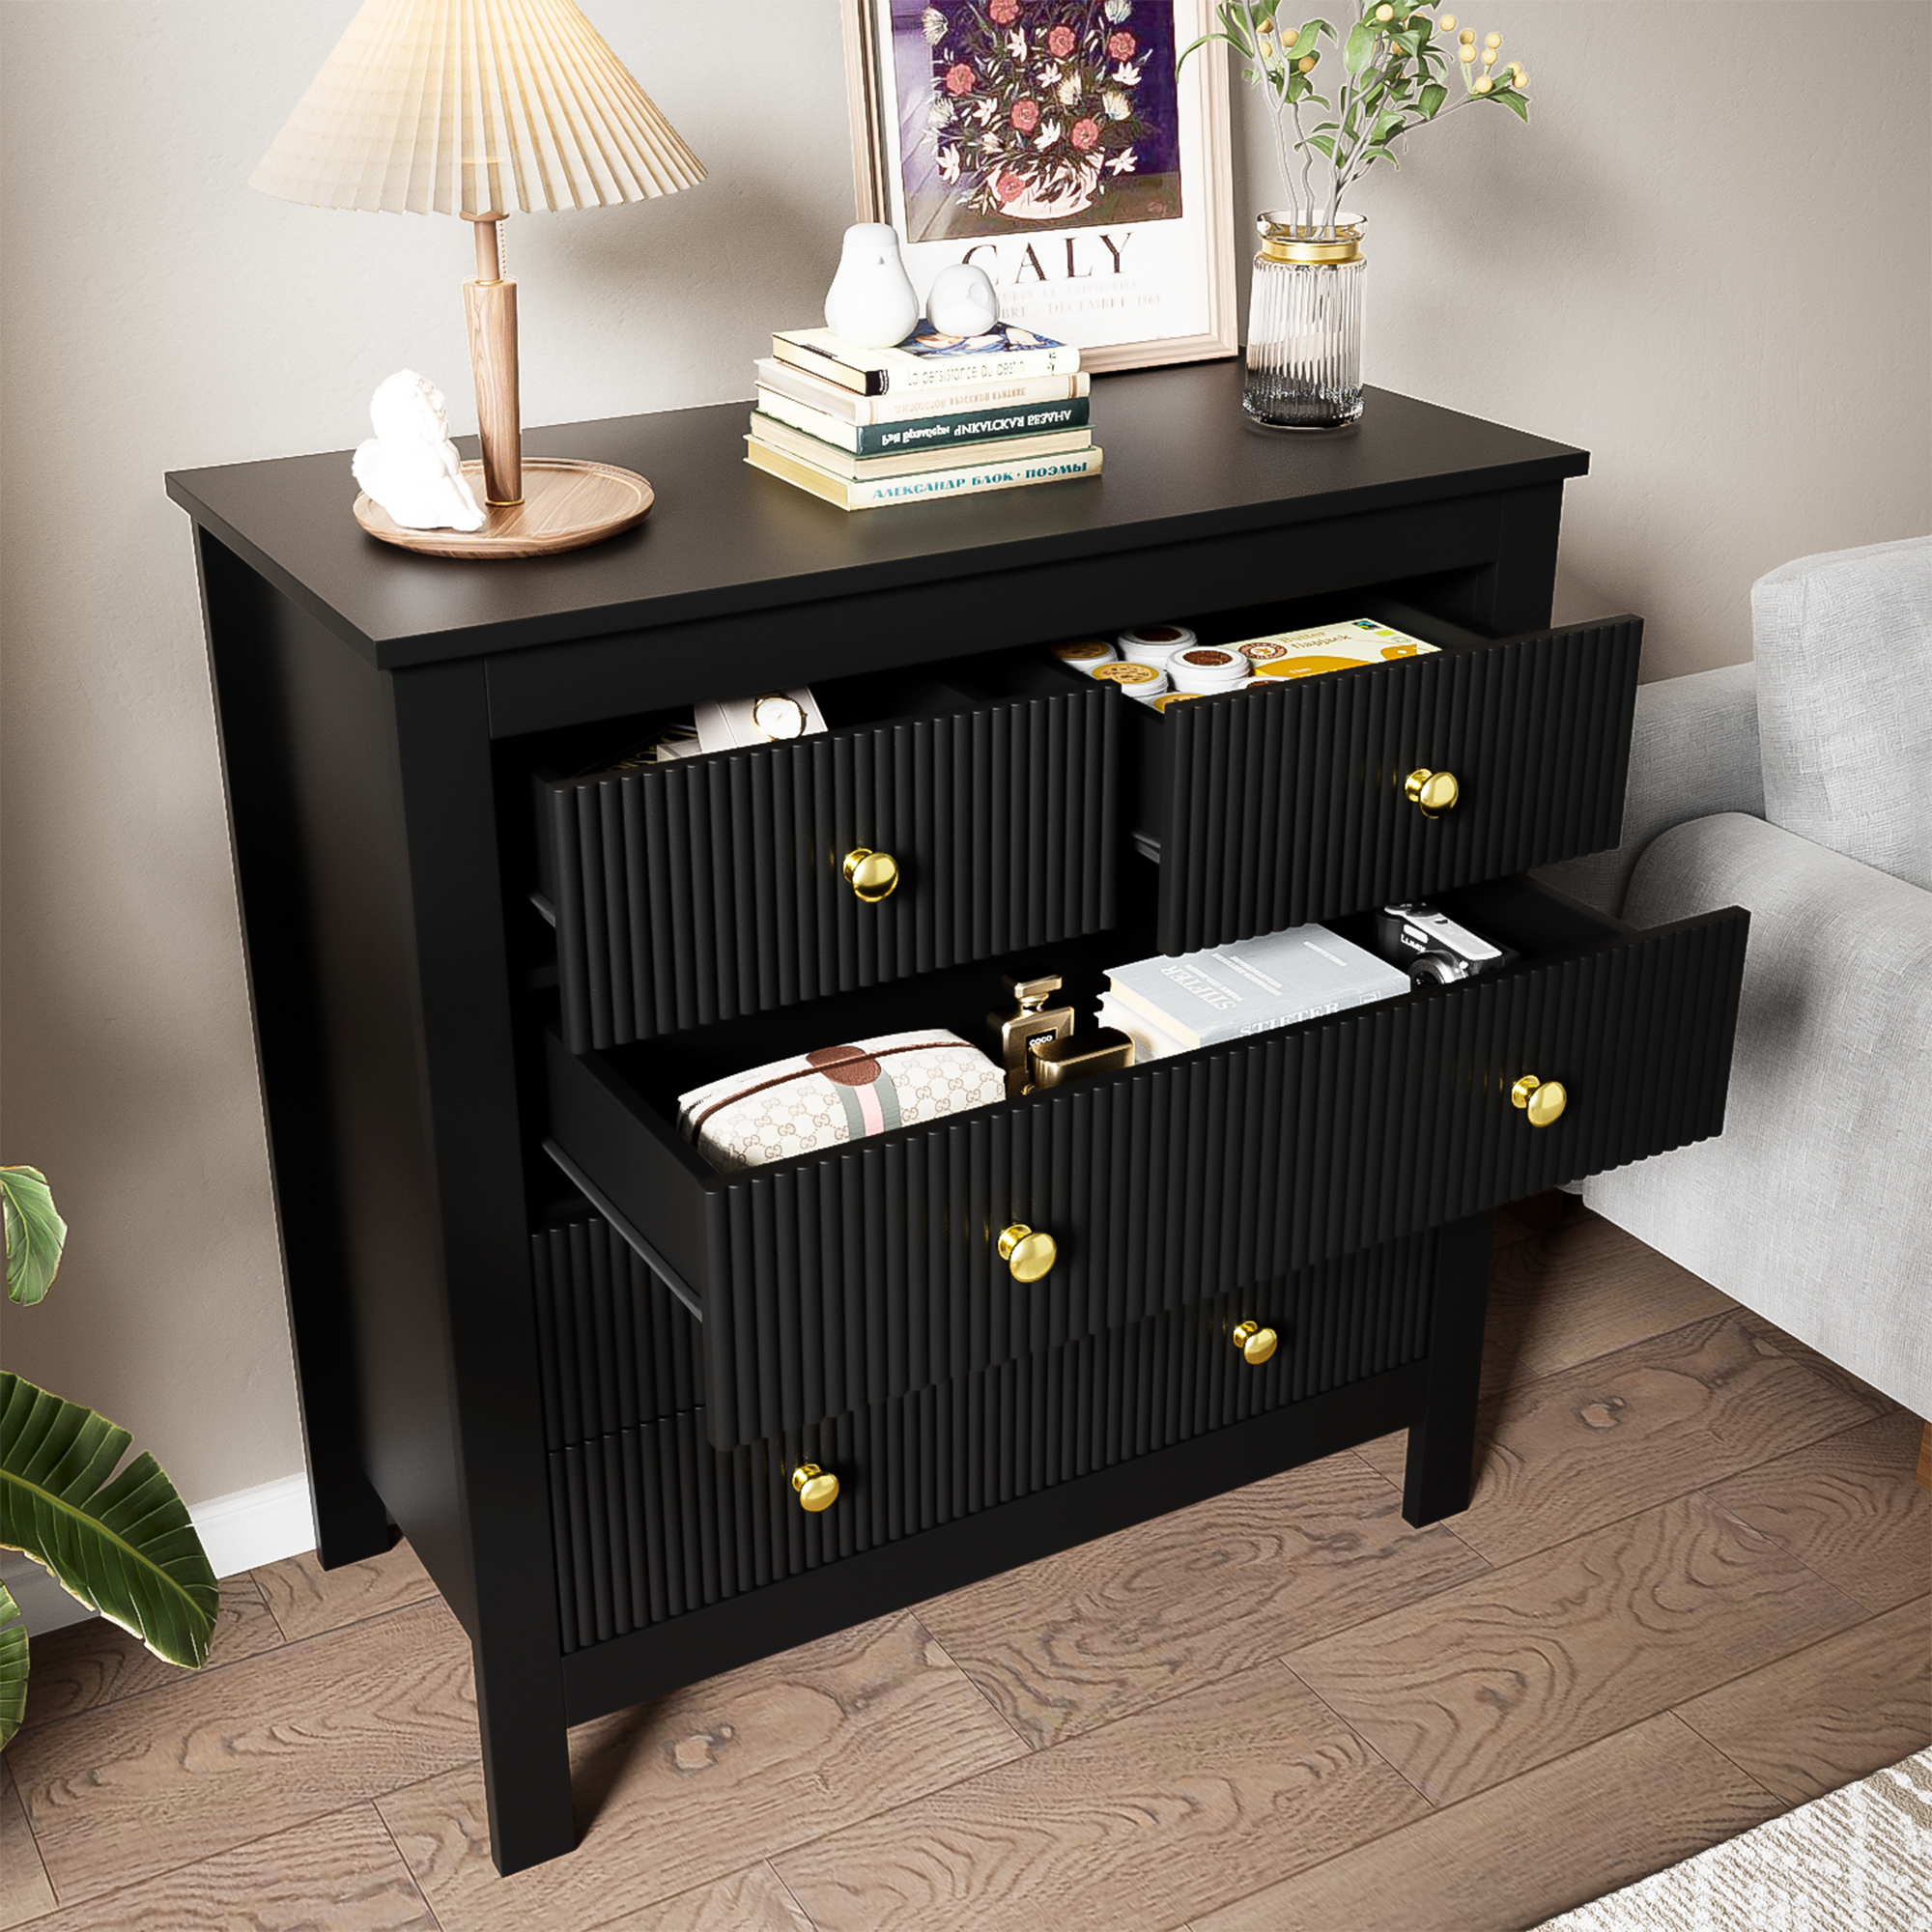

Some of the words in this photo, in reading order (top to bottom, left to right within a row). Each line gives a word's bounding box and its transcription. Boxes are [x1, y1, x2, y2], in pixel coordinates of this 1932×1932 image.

[872, 478, 966, 499] АЛЕКСАНДР
[971, 471, 1014, 487] БЛОК
[1025, 462, 1088, 479] ПОЭМЫ
[1029, 1035, 1053, 1047] COCO
